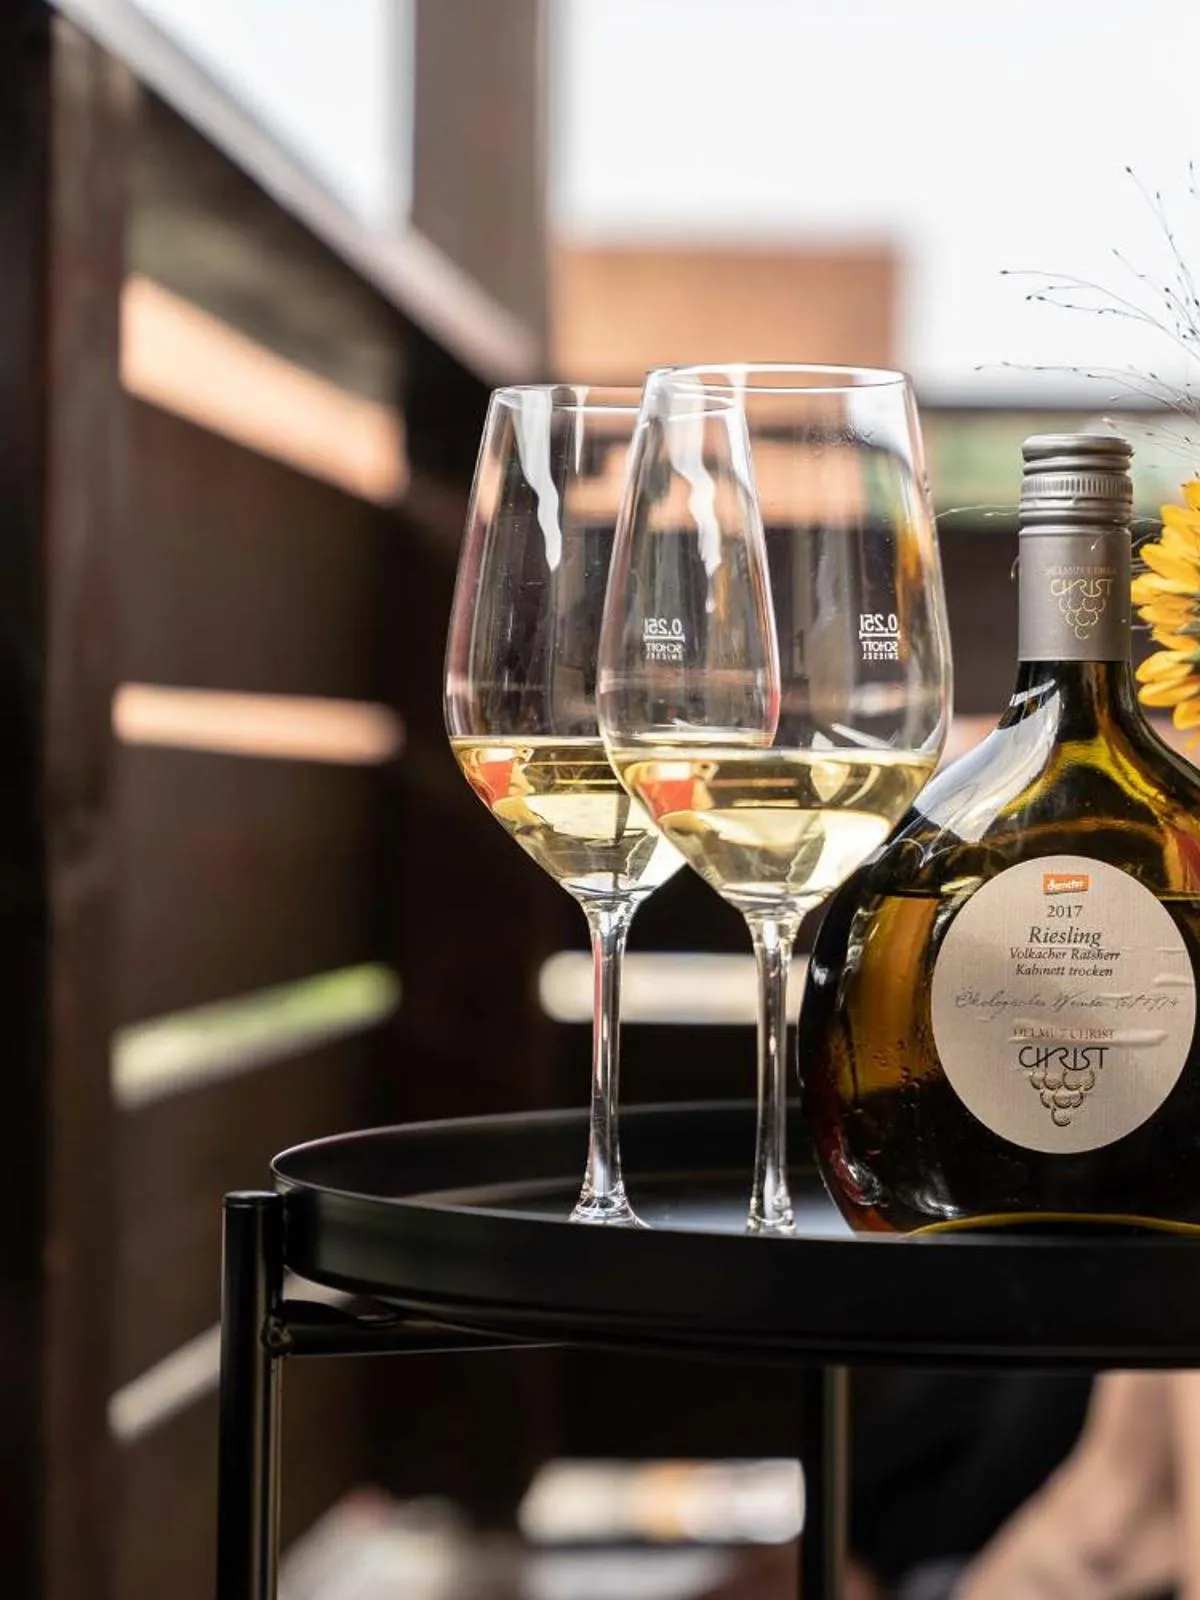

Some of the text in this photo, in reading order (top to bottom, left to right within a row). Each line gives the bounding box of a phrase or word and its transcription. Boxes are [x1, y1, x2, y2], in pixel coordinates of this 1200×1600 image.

[1050, 579, 1113, 598] CHRIST
[1047, 905, 1083, 918] 2017
[1027, 926, 1102, 947] Riesling
[1010, 948, 1067, 960] Volkacher
[1015, 963, 1114, 977] Kabinett trocken
[1018, 1046, 1110, 1071] CHRIST
